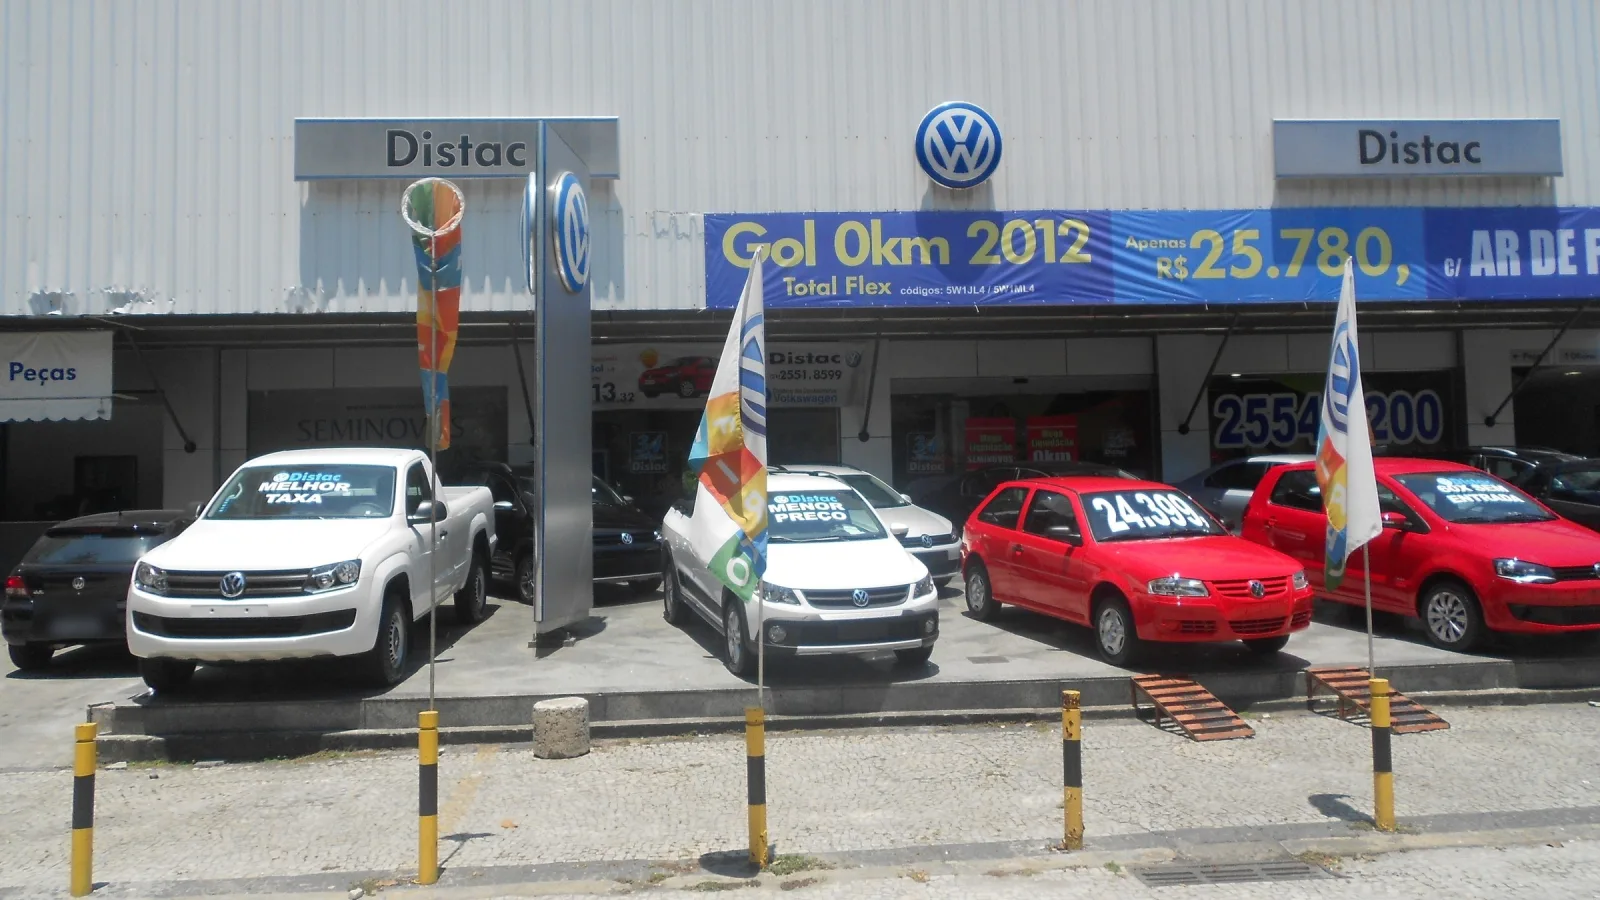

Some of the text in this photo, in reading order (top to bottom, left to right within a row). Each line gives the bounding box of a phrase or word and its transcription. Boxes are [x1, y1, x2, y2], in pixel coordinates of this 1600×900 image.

[386, 128, 526, 167] Distac
[1358, 129, 1481, 165] Distac
[721, 219, 1092, 269] Gol 0km 2012
[1125, 235, 1187, 251] Apenas
[1156, 226, 1410, 286] R$ 25.780,
[1443, 257, 1462, 277] c/
[1470, 229, 1521, 277] AR
[1529, 228, 1578, 276] DE
[782, 275, 837, 296] Total
[845, 275, 892, 296] Flex
[900, 286, 944, 297] códigos:
[946, 286, 985, 294] 5W1JL4
[769, 351, 841, 365] Distac
[9, 361, 77, 387] Peças
[780, 369, 842, 380] 2551.8599
[773, 394, 838, 405] Volkswagen
[296, 417, 465, 442] SEMINOVS
[632, 461, 667, 471] Distac
[909, 461, 944, 471] Distac
[288, 471, 342, 482] Distac
[258, 481, 351, 493] MELHOR
[265, 493, 323, 504] TAXA
[789, 494, 838, 503] Distac
[1446, 493, 1526, 504] ENTRADA
[768, 502, 846, 513] MENOR
